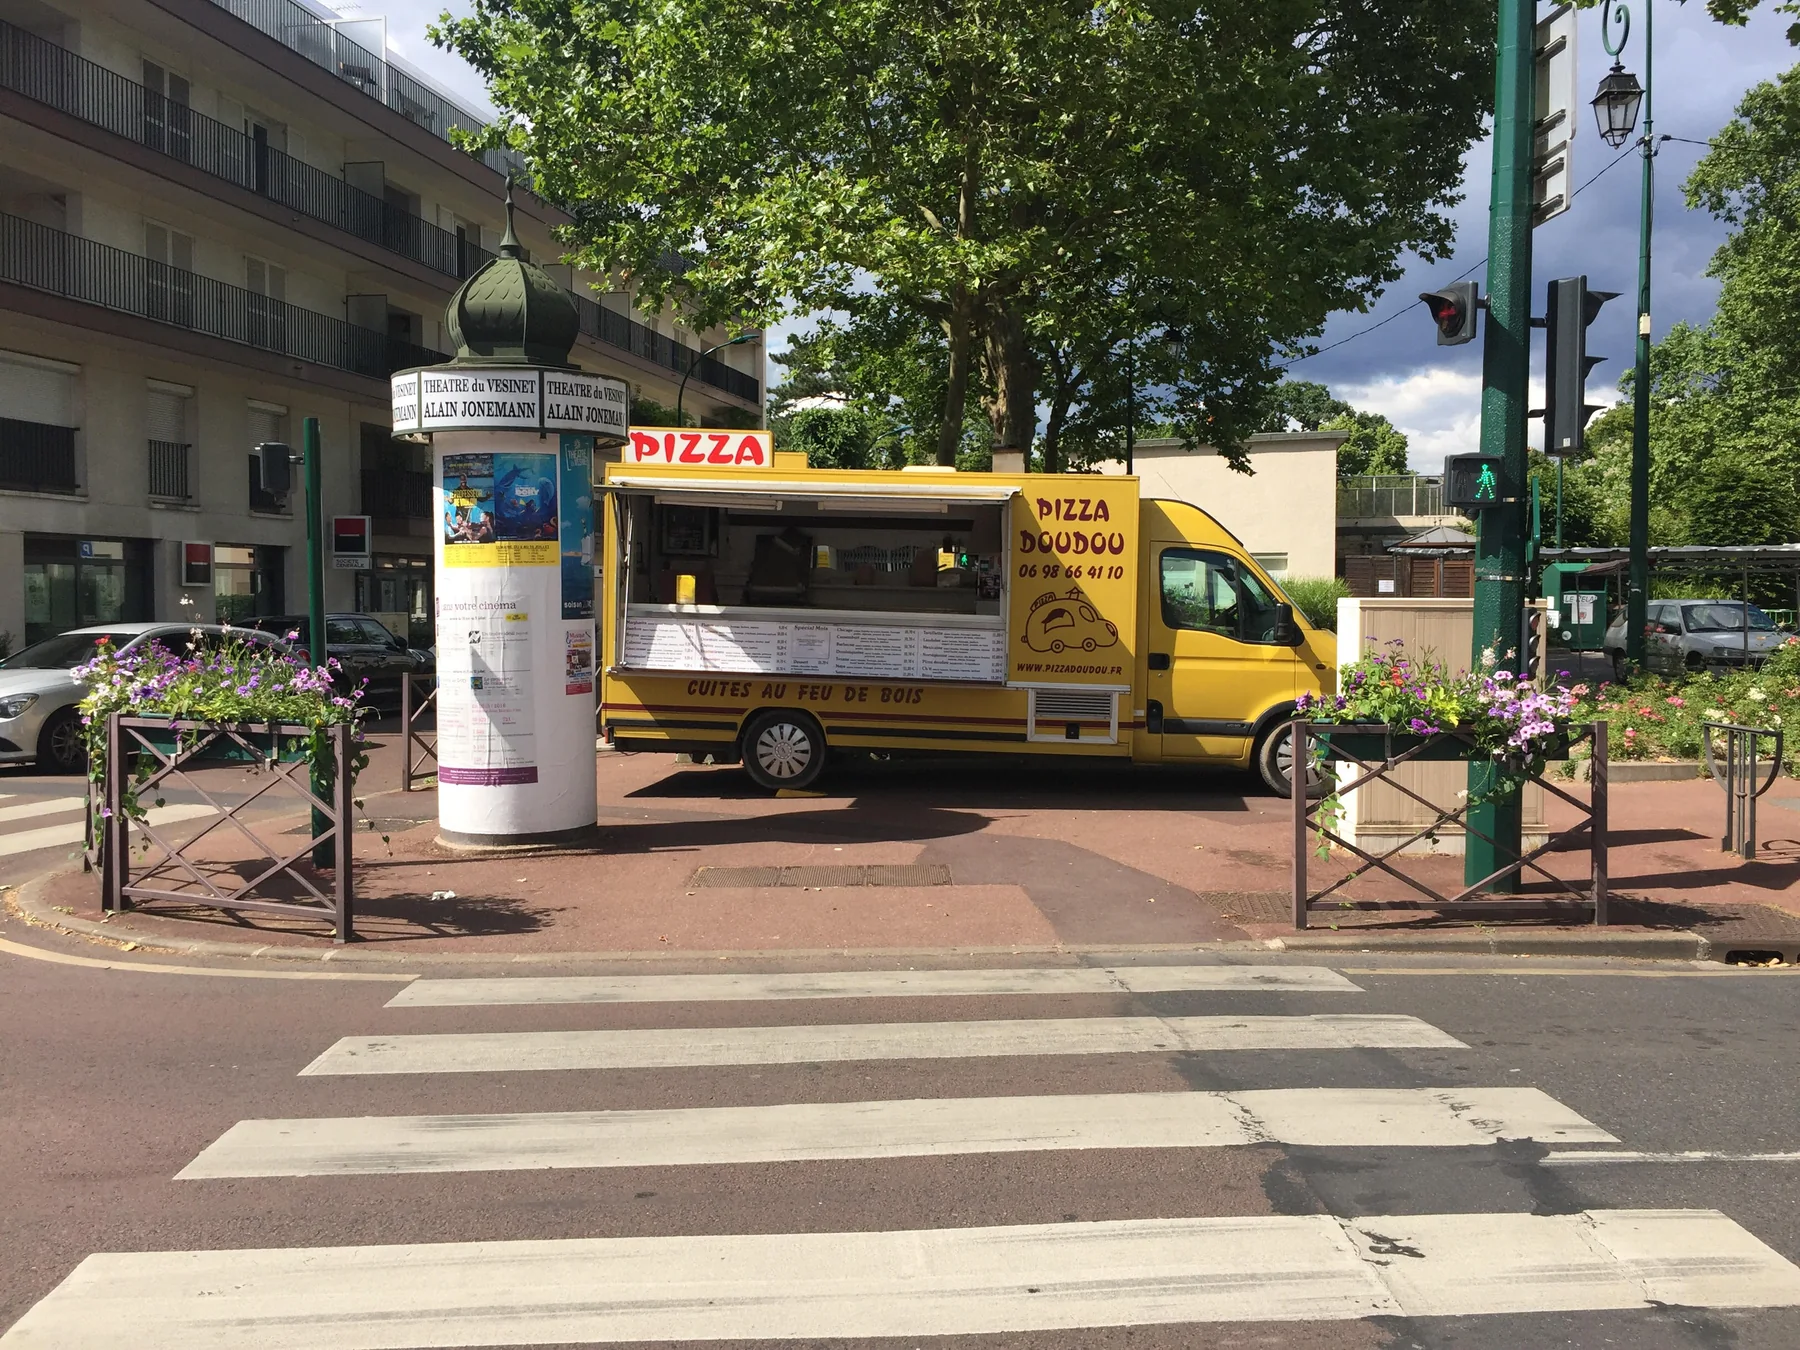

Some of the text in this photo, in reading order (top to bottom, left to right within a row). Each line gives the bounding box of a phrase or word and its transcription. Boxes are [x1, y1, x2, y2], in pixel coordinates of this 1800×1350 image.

[424, 378, 536, 394] THEATRE du VESINET
[546, 380, 592, 398] THEATRE
[594, 385, 602, 400] du
[424, 400, 536, 418] ALAIN JONEMANN
[546, 402, 583, 421] ALAIN
[630, 432, 764, 466] PIZZA
[1036, 498, 1109, 522] PIZZA
[1020, 530, 1124, 555] DOUDOU
[1019, 564, 1124, 579] 06 98 66 41 10
[1034, 594, 1054, 608] PIZZA
[1017, 662, 1122, 676] WWW.PIZZADOUDOU.FR
[687, 679, 924, 704] CUITES AU FEU DE BOIS
